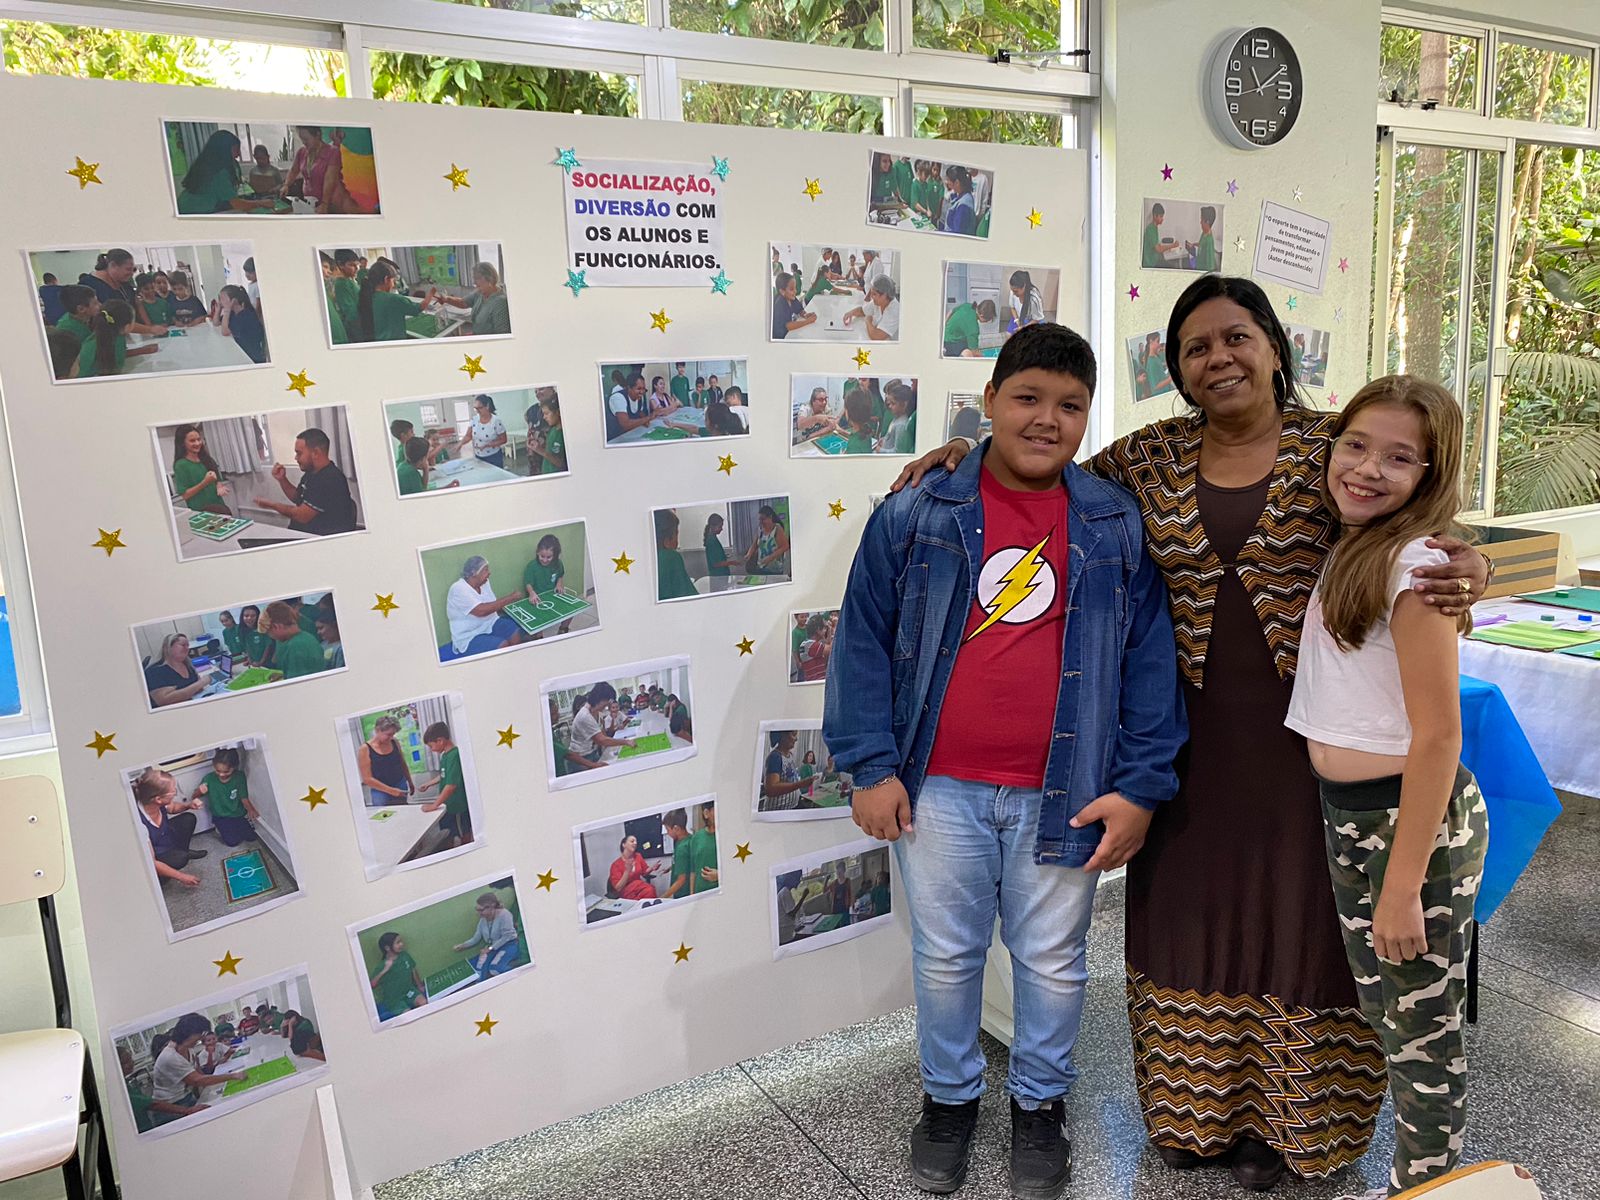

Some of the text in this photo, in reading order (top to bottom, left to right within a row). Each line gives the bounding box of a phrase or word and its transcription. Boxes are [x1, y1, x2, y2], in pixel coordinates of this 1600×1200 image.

[1243, 45, 1248, 55] 11
[1251, 38, 1269, 58] 12
[1230, 60, 1241, 71] 10
[1279, 64, 1287, 75] 2
[1226, 77, 1242, 96] 9
[1277, 81, 1292, 100] 3
[1230, 103, 1239, 113] 8
[1279, 106, 1286, 117] 4
[1239, 120, 1248, 131] 7
[1252, 119, 1267, 137] 6
[1268, 120, 1276, 131] 5
[572, 173, 715, 195] SOCIALIZAÇÃO,
[574, 199, 716, 219] DIVERSÃO COM
[585, 226, 709, 243] OS ALUNOS E
[1272, 218, 1289, 228] esporte
[1290, 223, 1298, 231] tem
[1303, 228, 1326, 240] capacidade
[1285, 231, 1311, 244] transformar
[1265, 235, 1295, 249] pensamentos,
[1296, 245, 1317, 255] educando
[1270, 245, 1284, 254] jovem
[574, 251, 721, 269] FUNCIONÁRIOS.
